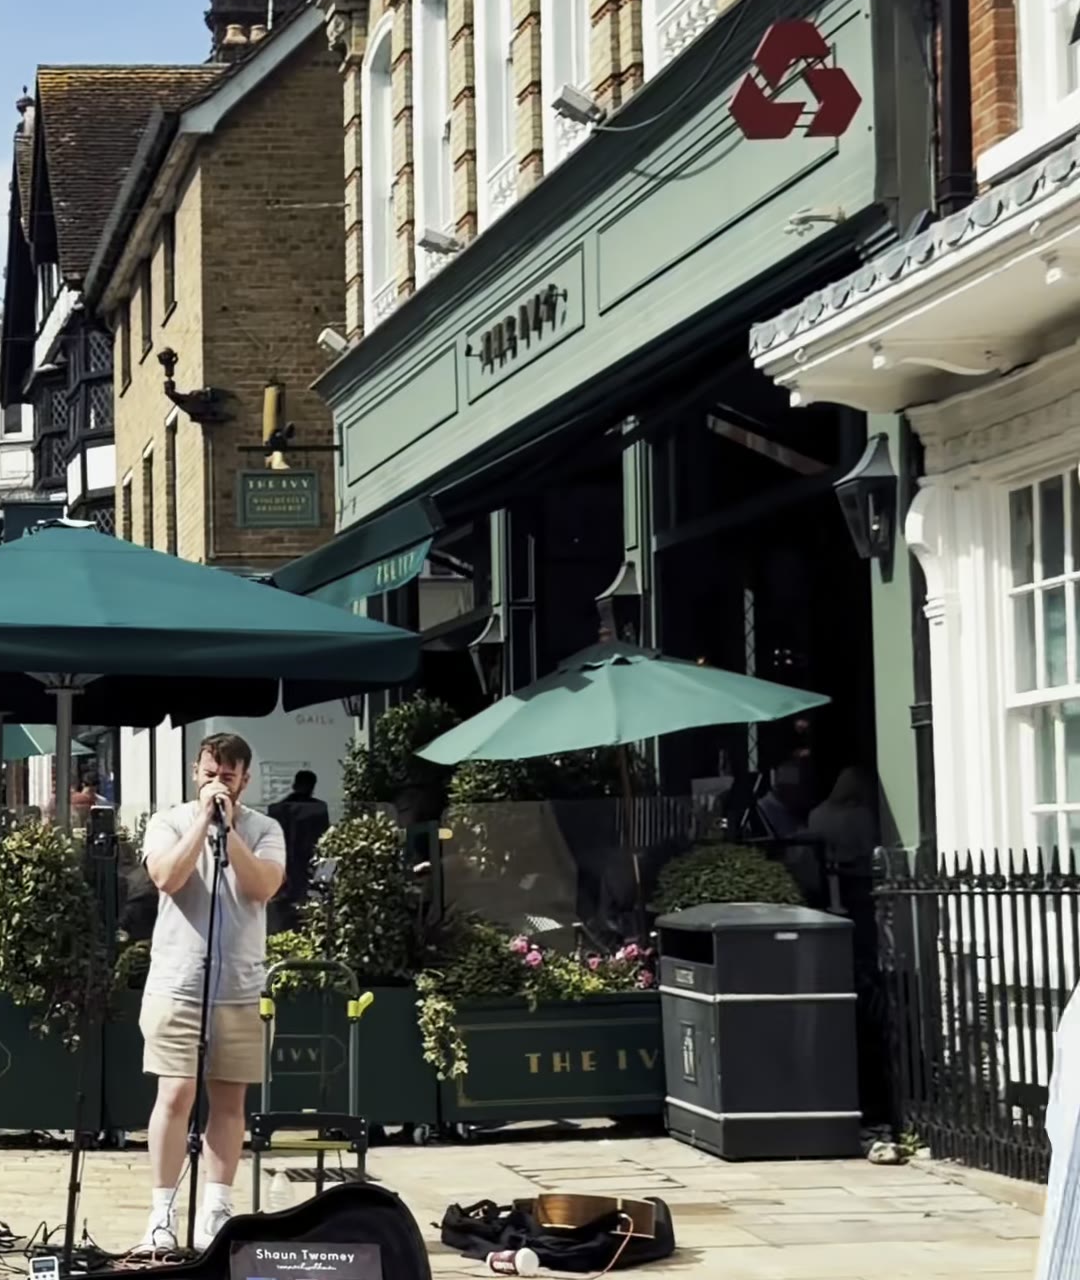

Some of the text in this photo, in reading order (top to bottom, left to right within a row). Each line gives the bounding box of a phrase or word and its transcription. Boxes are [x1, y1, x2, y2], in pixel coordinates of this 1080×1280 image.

[248, 479, 309, 489] THE IVY
[276, 1047, 319, 1062] IVY
[524, 1048, 659, 1074] THE IV
[255, 1248, 355, 1264] Shaun Twomey
